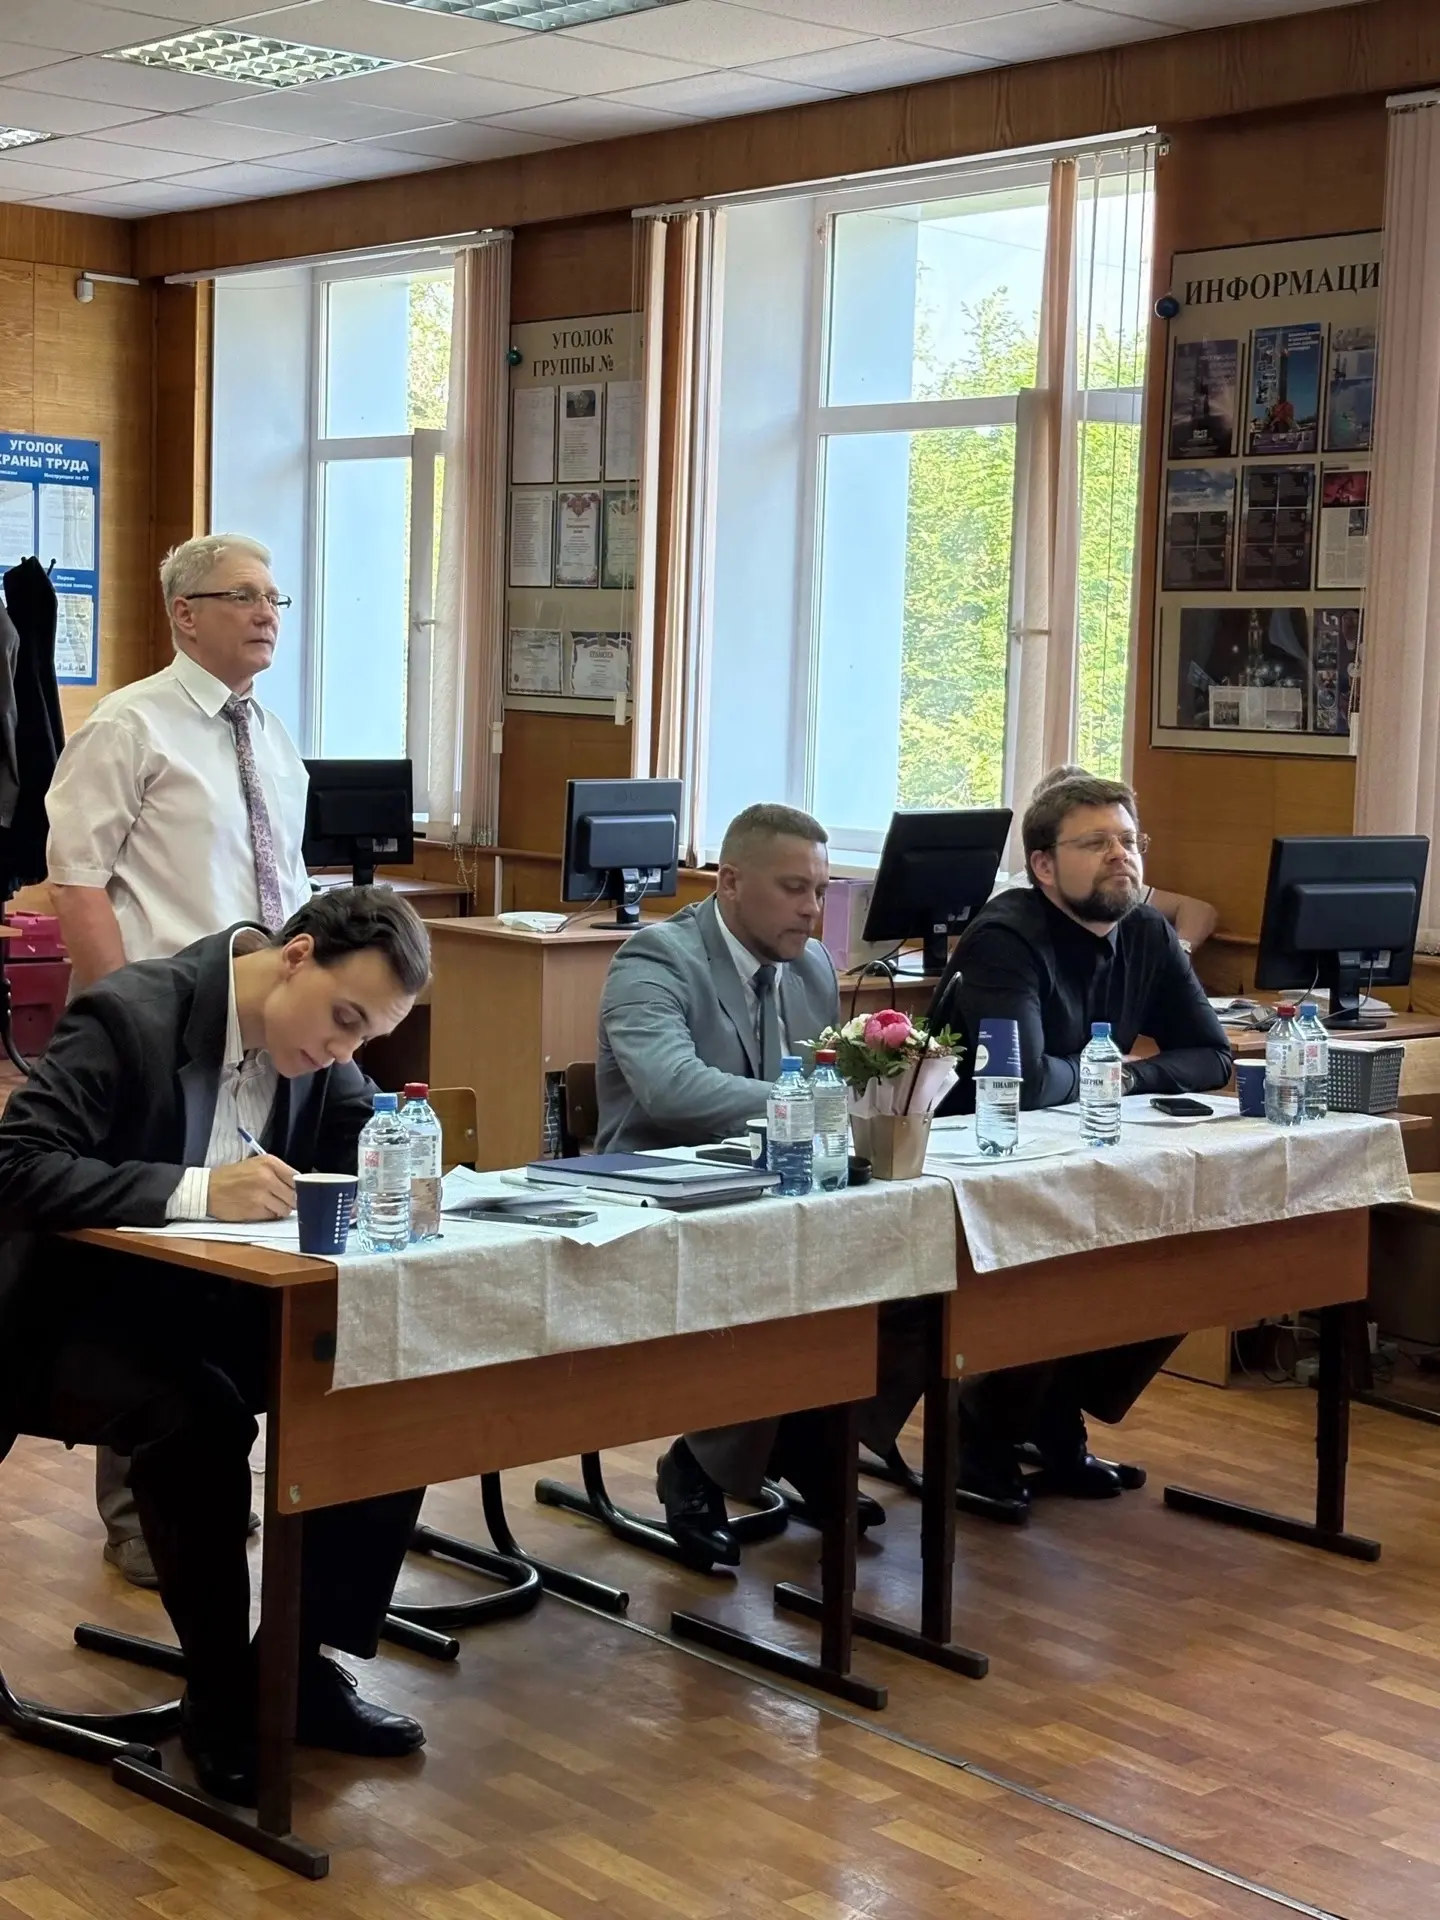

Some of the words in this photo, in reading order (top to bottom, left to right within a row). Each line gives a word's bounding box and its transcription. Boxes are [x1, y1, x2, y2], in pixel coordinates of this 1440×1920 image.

[1185, 261, 1380, 305] ИНФОРМАЦИ
[552, 328, 614, 349] УГОЛОК
[533, 356, 595, 377] ГРУППЫ
[599, 354, 614, 372] №
[9, 439, 63, 455] УГОЛОК
[0, 453, 42, 468] РАНЫ
[46, 458, 89, 473] ТРУДА
